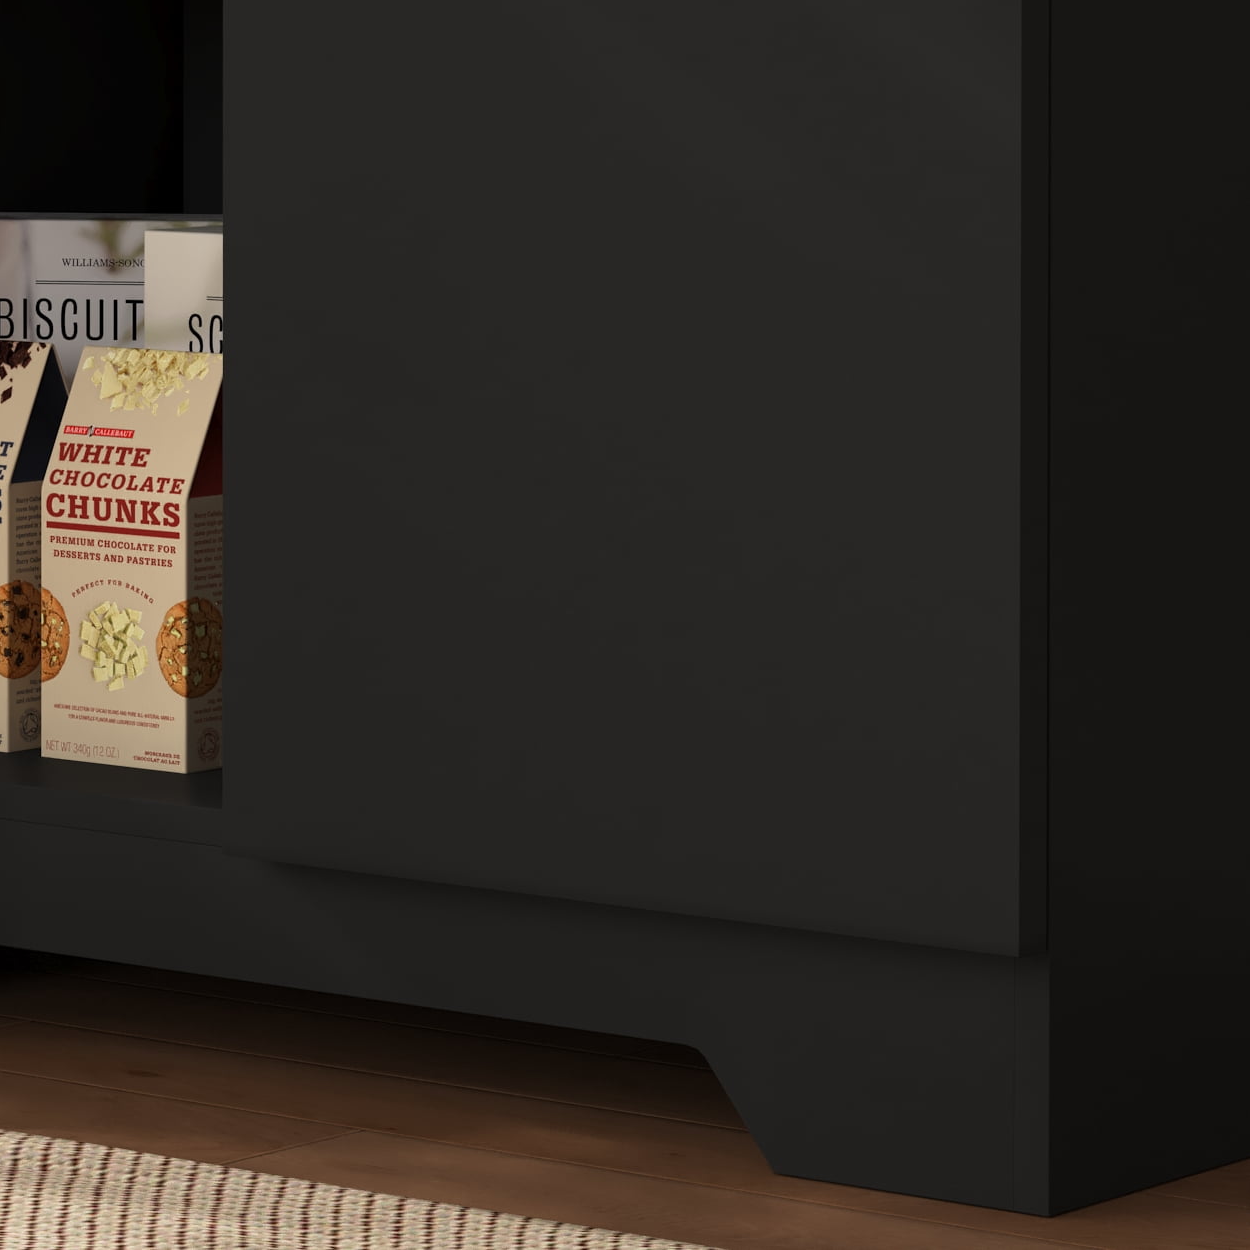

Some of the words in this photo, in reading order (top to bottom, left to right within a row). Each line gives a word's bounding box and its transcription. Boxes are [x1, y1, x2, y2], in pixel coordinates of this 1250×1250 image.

[189, 314, 223, 354] SC
[58, 442, 151, 468] WHITE
[49, 469, 185, 495] CHOCOLATE
[46, 493, 180, 528] CHUNKS
[50, 536, 95, 547] PREMIUM
[98, 540, 154, 552] CHOCOLATE
[158, 545, 176, 554] FOR
[54, 550, 101, 561] DESSERTS
[104, 554, 124, 563] AND
[126, 556, 173, 568] PASTRIES
[72, 580, 104, 598] PERFECT
[126, 583, 154, 604] BAKING
[46, 740, 59, 750] NET
[61, 741, 71, 752] WT
